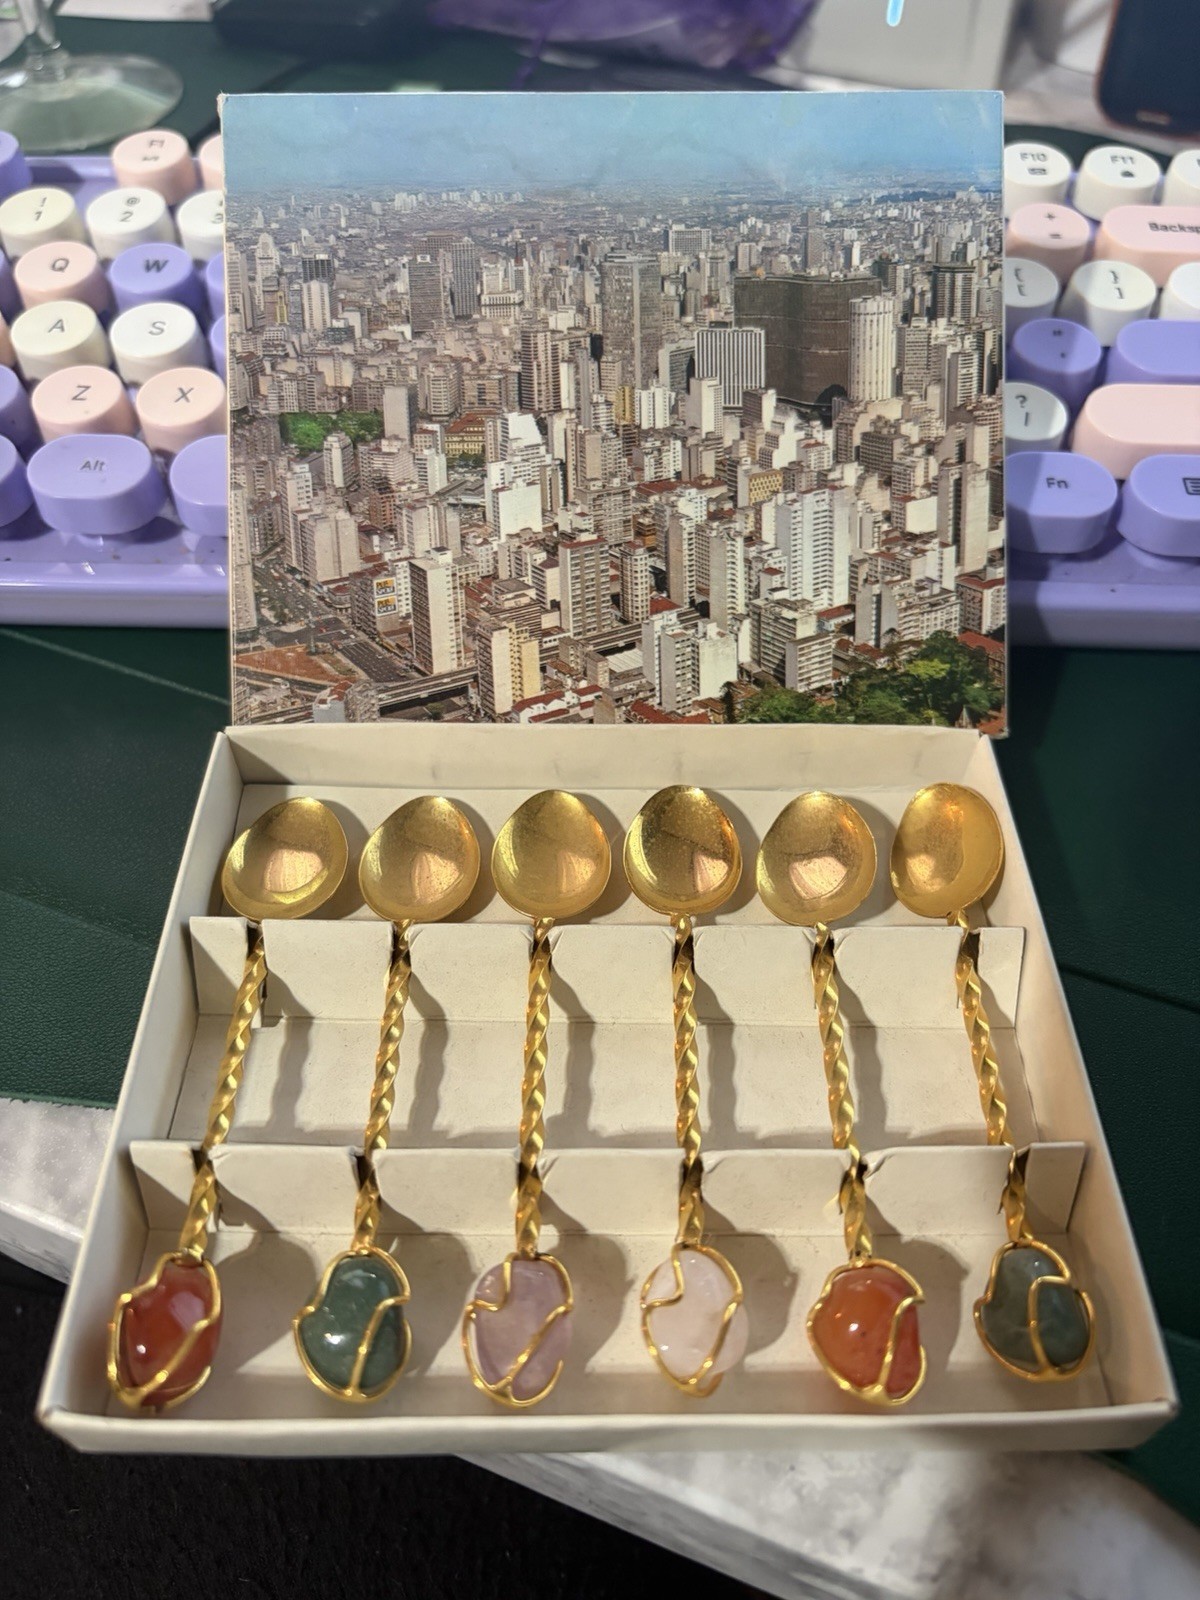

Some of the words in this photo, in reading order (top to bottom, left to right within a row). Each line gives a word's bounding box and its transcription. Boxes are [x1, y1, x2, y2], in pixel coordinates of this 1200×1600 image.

[1020, 152, 1049, 163] F10
[1110, 155, 1136, 165] F11
[126, 197, 140, 206] @
[119, 211, 134, 222] 2
[51, 258, 70, 272] Q
[143, 259, 169, 273] W
[48, 319, 65, 333] A
[148, 321, 167, 336] S
[71, 385, 91, 401] Z
[174, 387, 194, 403] X
[1015, 395, 1028, 408] ?
[80, 460, 106, 472] Alt
[1045, 477, 1069, 489] Fn
